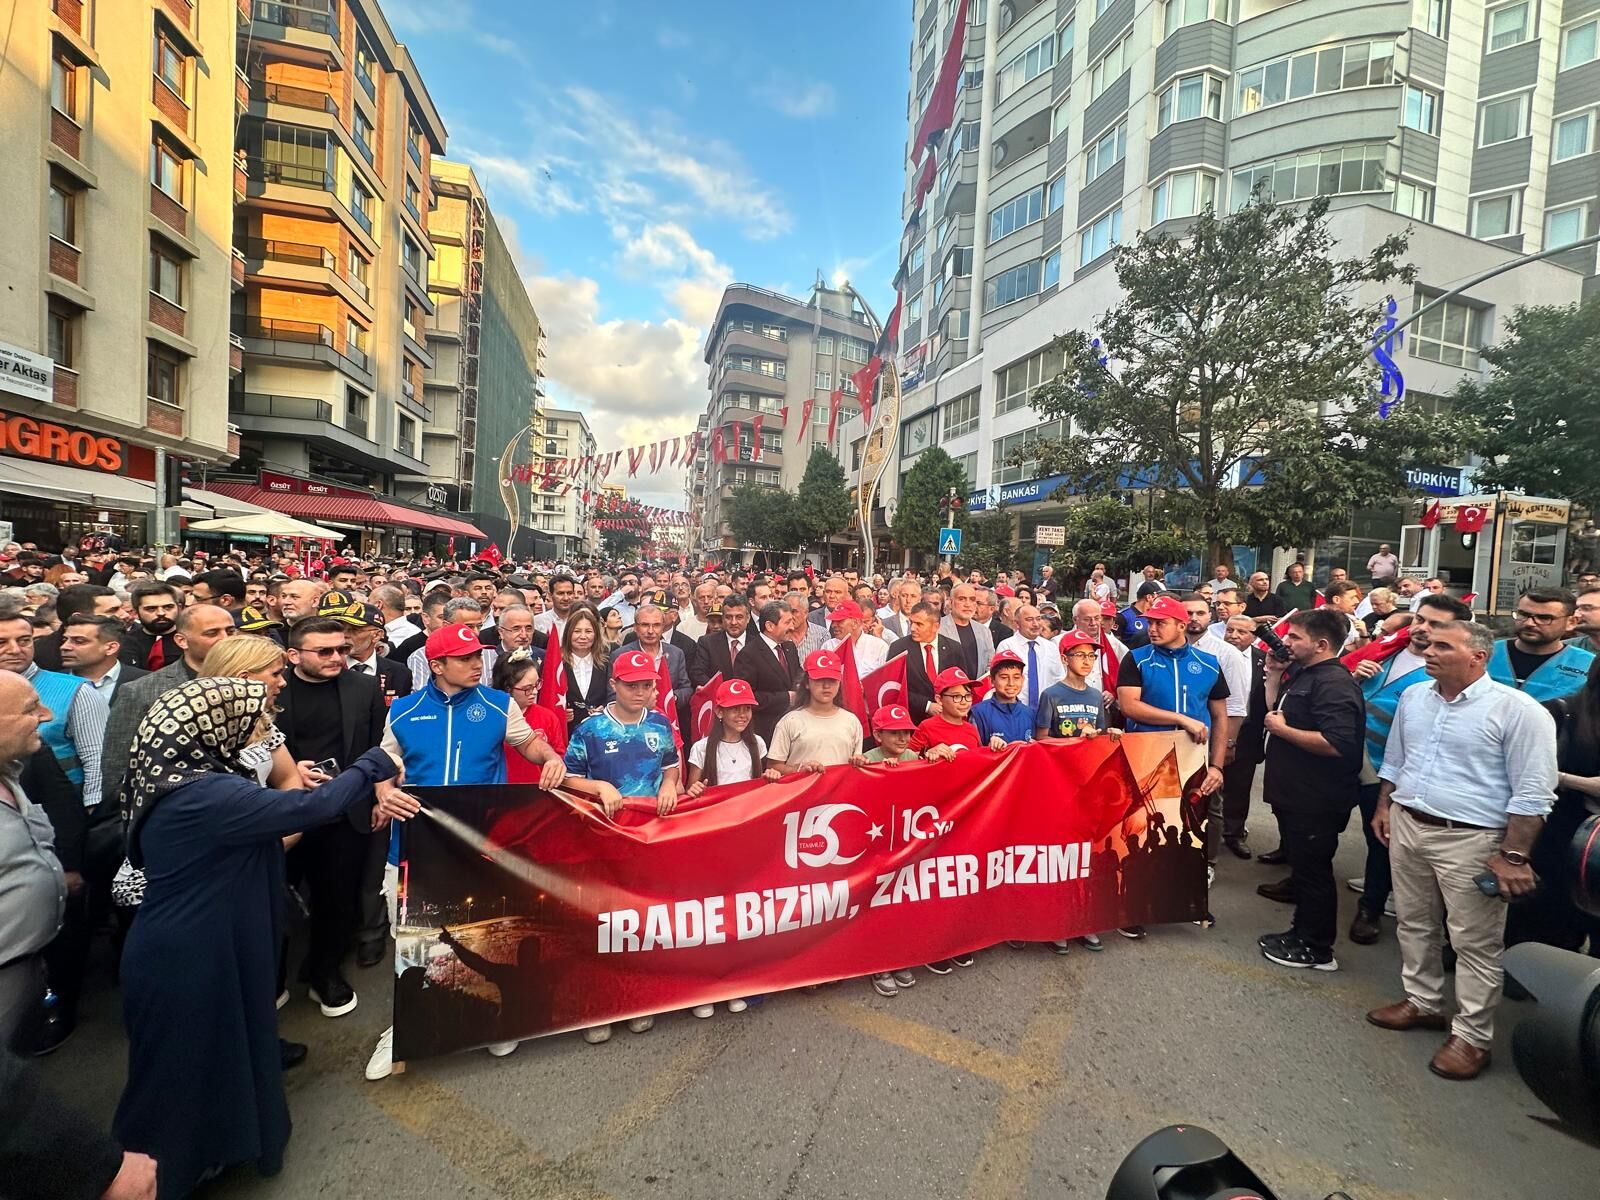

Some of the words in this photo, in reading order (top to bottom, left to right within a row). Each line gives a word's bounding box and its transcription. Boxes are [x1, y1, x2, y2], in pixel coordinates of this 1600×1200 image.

[12, 363, 47, 385] Aktaş
[270, 482, 291, 490] ÖZSÜT
[1406, 468, 1458, 489] TÜRKİYE
[307, 485, 328, 493] ÖZSÜT
[428, 482, 447, 504] ÖZSÜT
[1002, 485, 1039, 500] BANKASI
[1056, 703, 1086, 713] BRAWL
[799, 841, 825, 849] TEMMUZ
[597, 896, 726, 954] İRADE
[736, 879, 860, 939] BİZİM,
[870, 855, 979, 909] ZAFER
[986, 841, 1092, 887] BİZİM!
